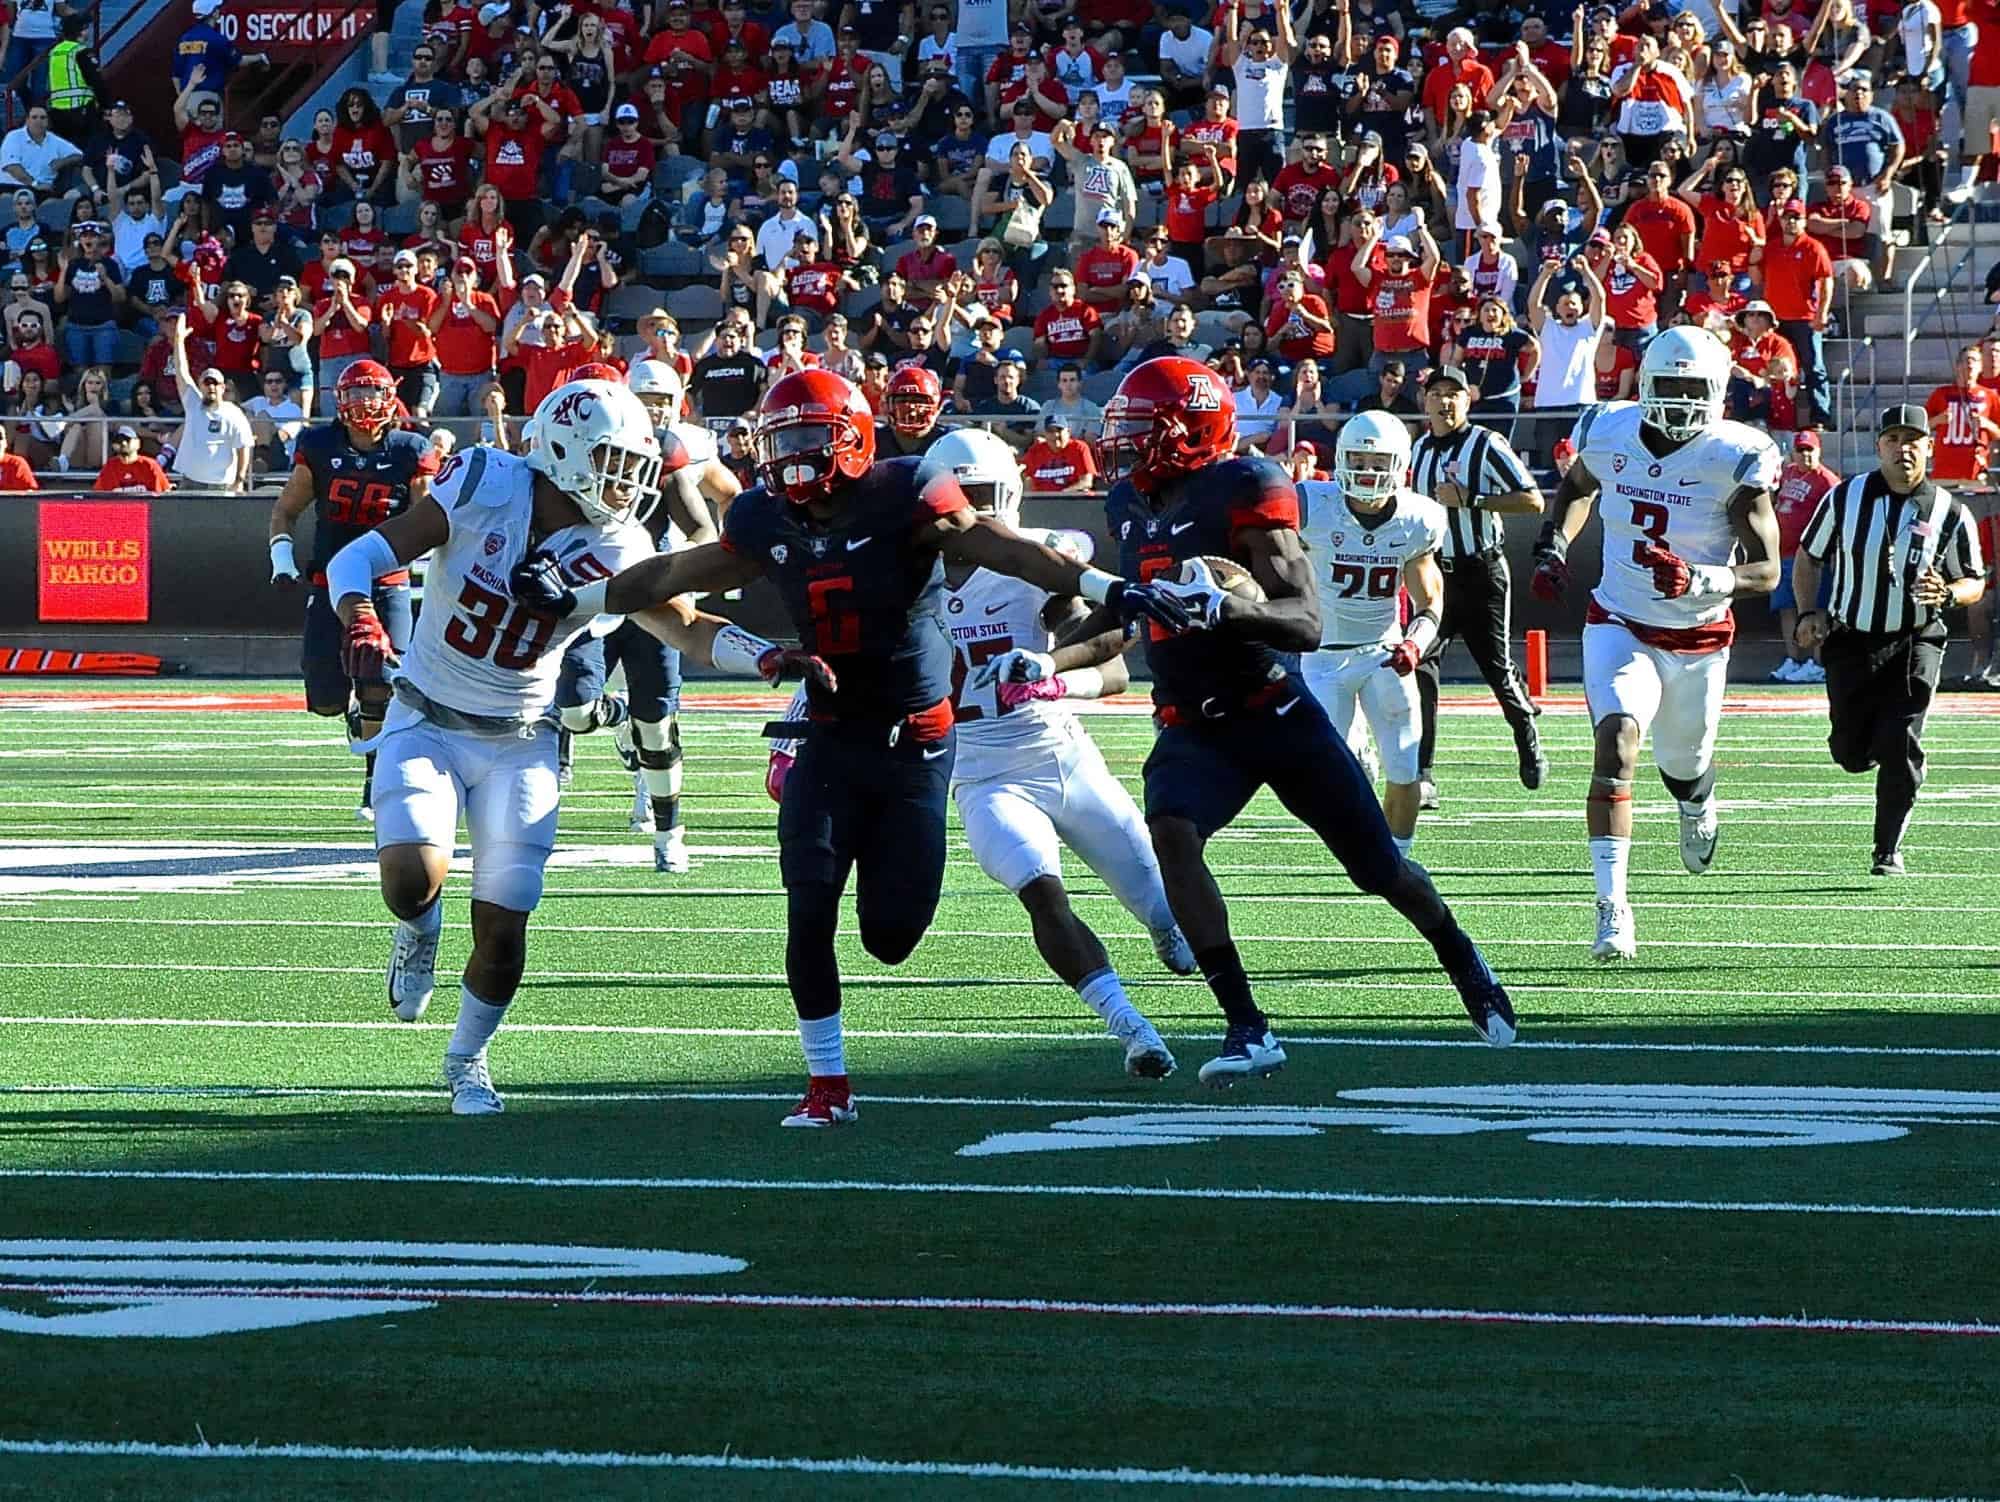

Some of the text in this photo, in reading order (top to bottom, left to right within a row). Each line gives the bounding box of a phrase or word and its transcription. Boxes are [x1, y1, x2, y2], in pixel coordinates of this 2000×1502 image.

[246, 14, 332, 41] SECTION
[1467, 336, 1504, 349] BEAR
[1187, 374, 1220, 411] A
[1616, 483, 1692, 507] WASHINGTON STATE
[1629, 499, 1671, 568] 3
[45, 540, 141, 560] WELLS
[49, 564, 138, 584] FARGO
[444, 577, 560, 671] 30
[980, 622, 1009, 637] STATE
